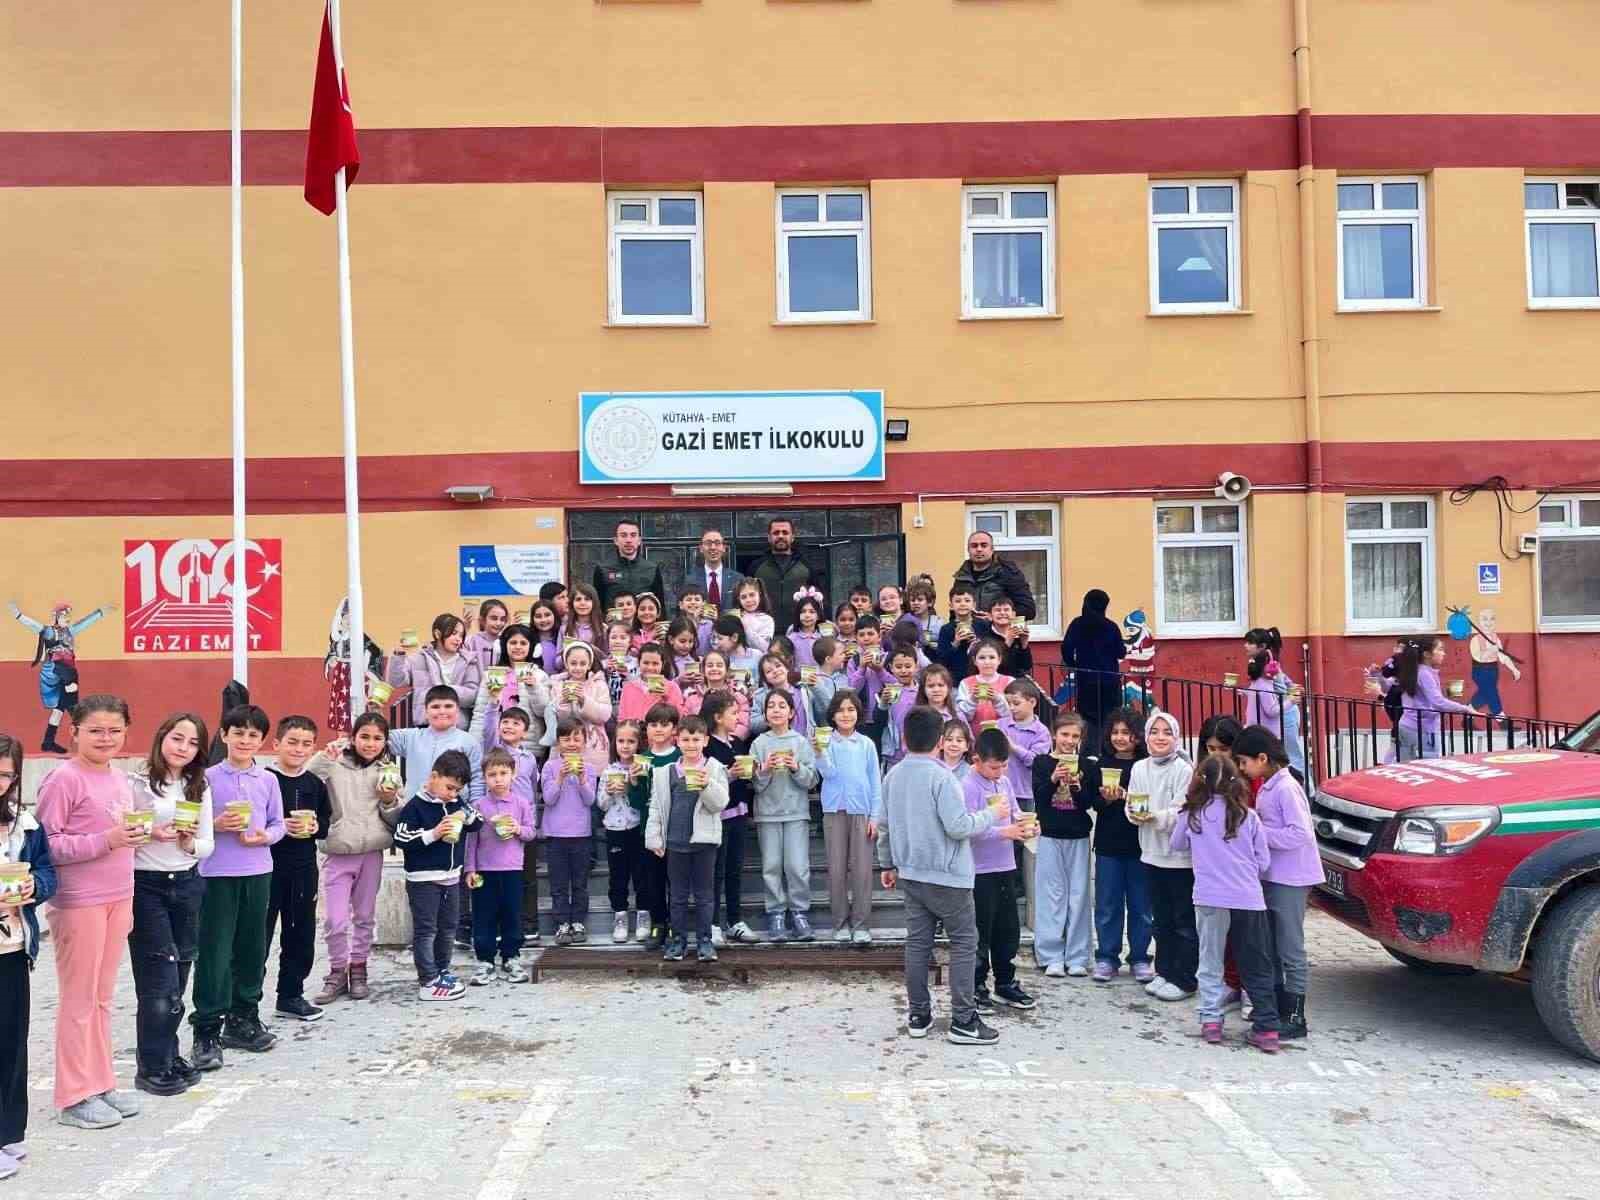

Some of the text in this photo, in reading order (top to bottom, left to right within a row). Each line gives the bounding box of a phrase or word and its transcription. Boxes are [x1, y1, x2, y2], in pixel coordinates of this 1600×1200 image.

[662, 411, 705, 424] KÜTAHYA
[712, 412, 737, 424] EMET
[661, 426, 864, 450] GAZİ EMET İLKOKULU
[200, 633, 262, 651] EMT
